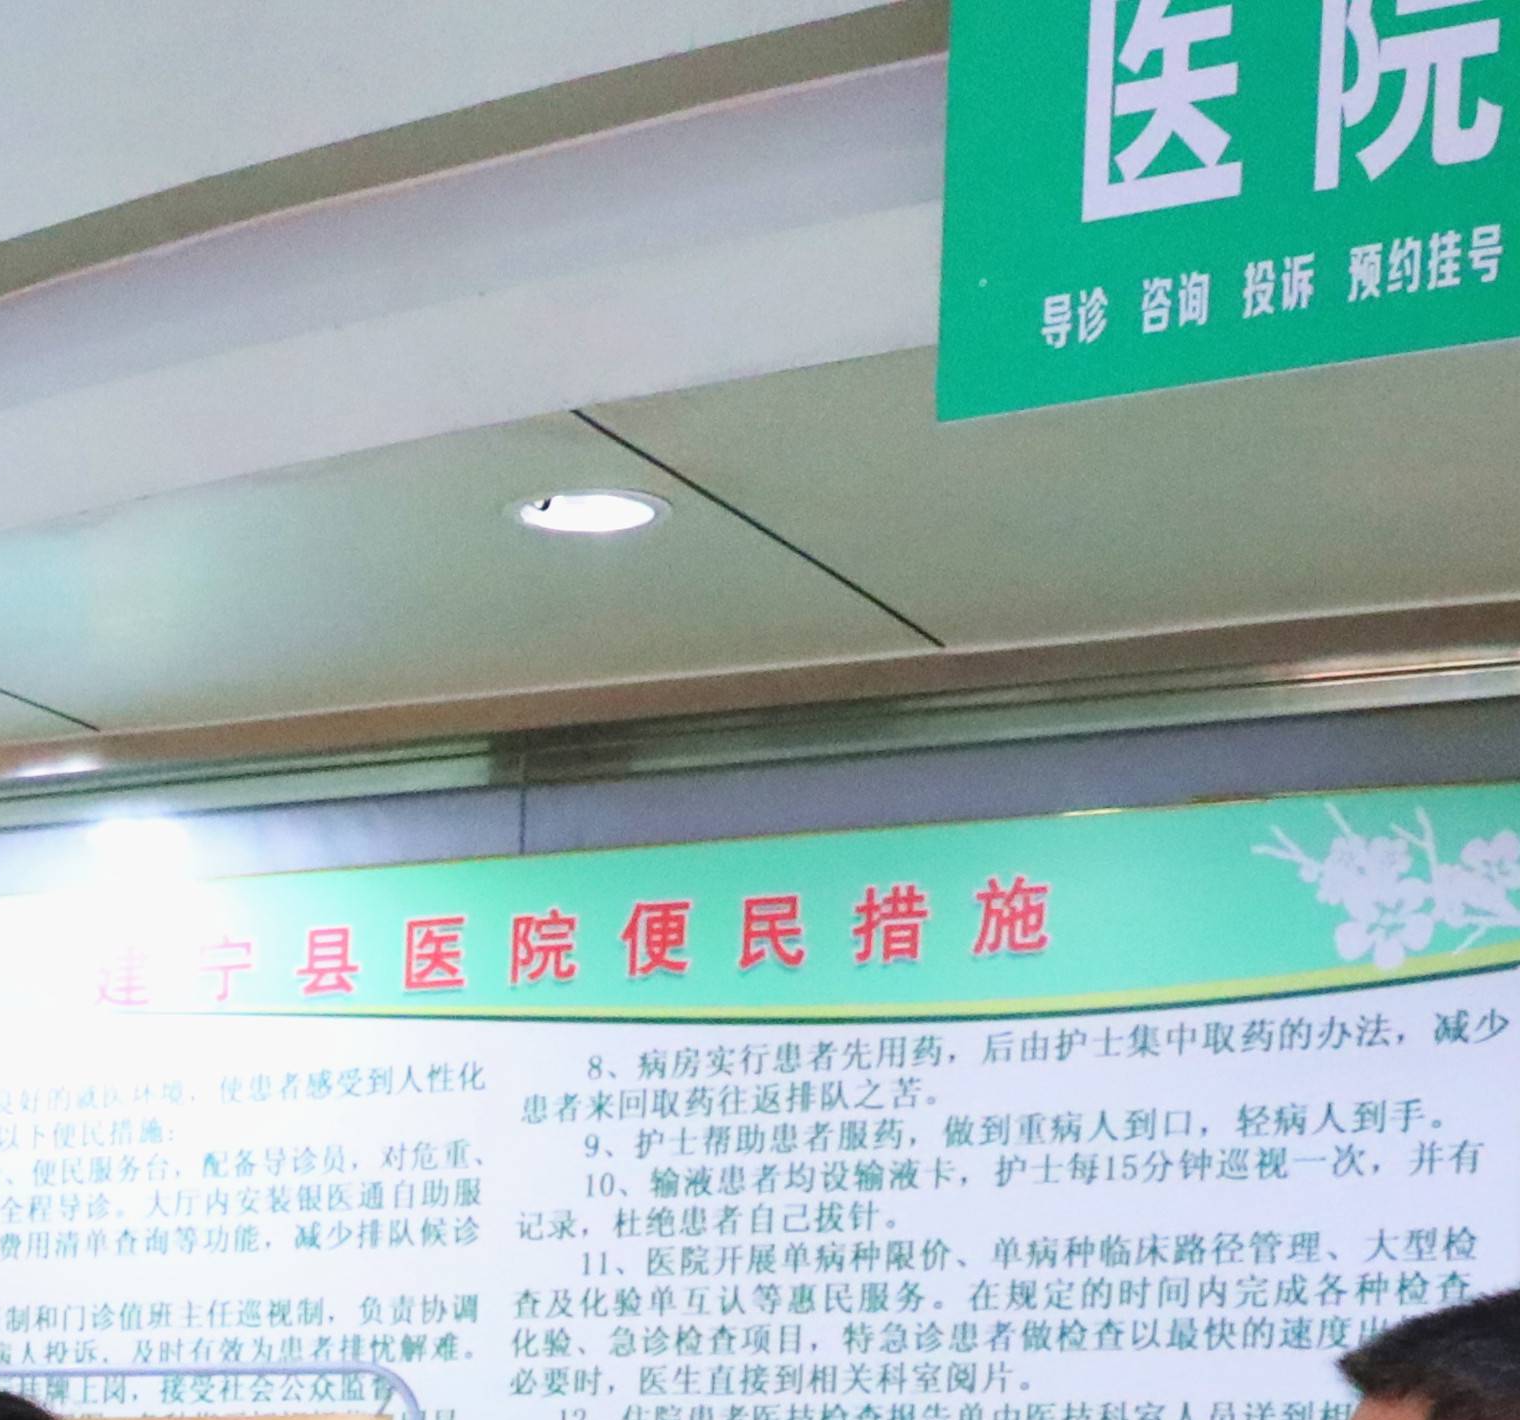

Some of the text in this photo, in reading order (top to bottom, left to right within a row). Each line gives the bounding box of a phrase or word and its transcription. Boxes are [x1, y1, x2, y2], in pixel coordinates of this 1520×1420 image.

[1041, 285, 1109, 349] 导诊
[1140, 271, 1211, 334] 咨询
[1242, 251, 1316, 320] 投诉
[1348, 223, 1505, 303] 预约挂号
[96, 876, 1051, 1008] 建宁县医院便民措施
